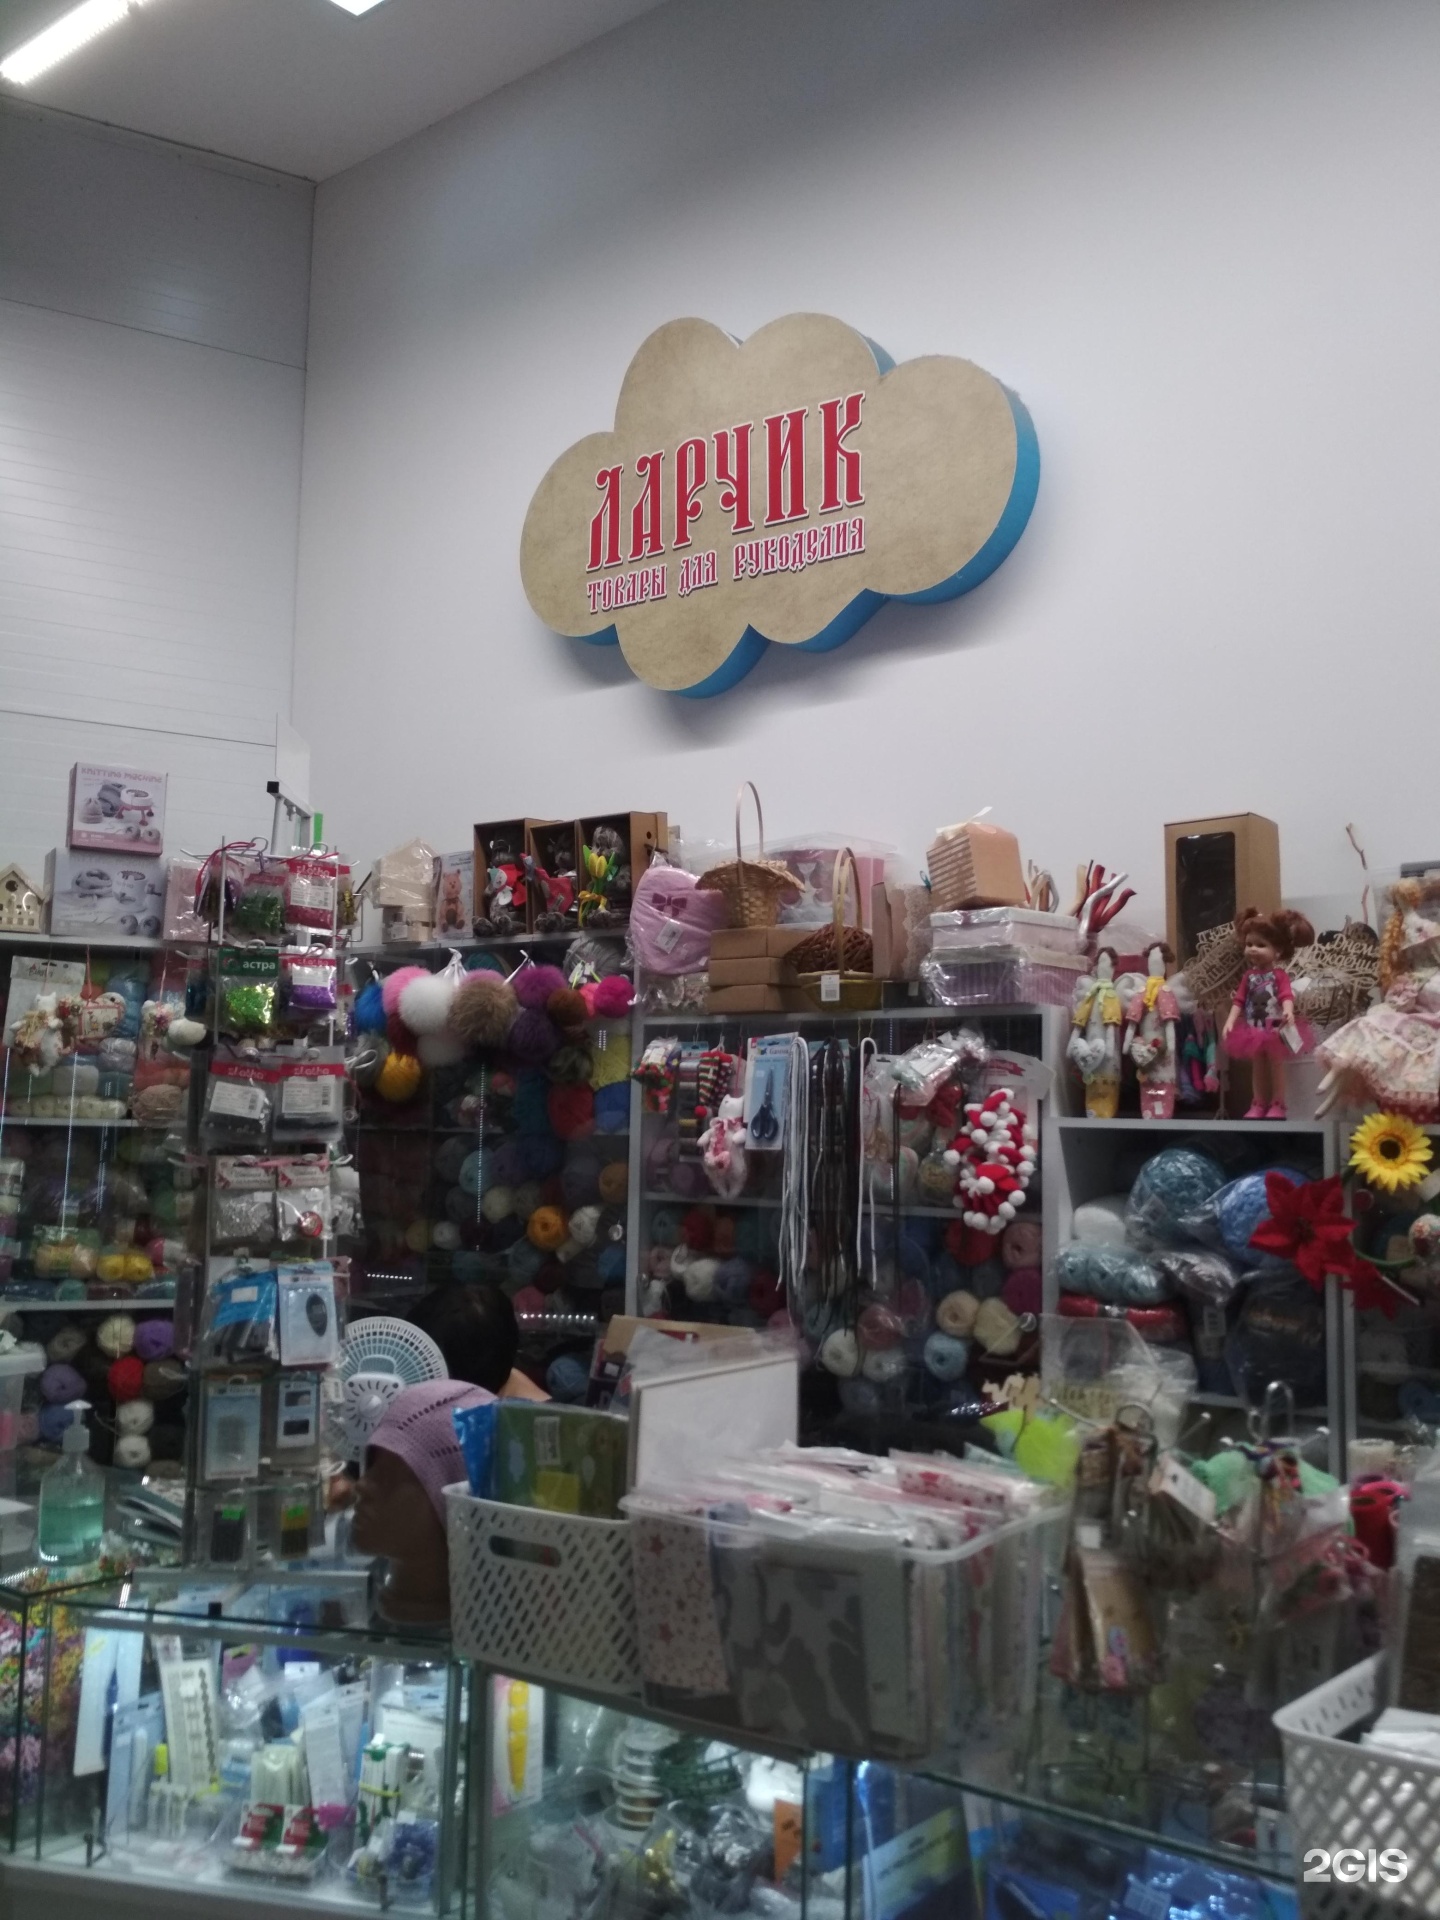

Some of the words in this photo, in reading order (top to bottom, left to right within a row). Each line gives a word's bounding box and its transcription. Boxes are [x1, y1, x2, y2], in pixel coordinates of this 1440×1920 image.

[586, 390, 866, 572] ЛАРЧИК
[587, 564, 667, 613] ТОВАРЫ
[678, 551, 718, 596] ДЛЯ
[733, 517, 866, 580] РУКОДЕЛИЯ
[243, 961, 276, 971] астра
